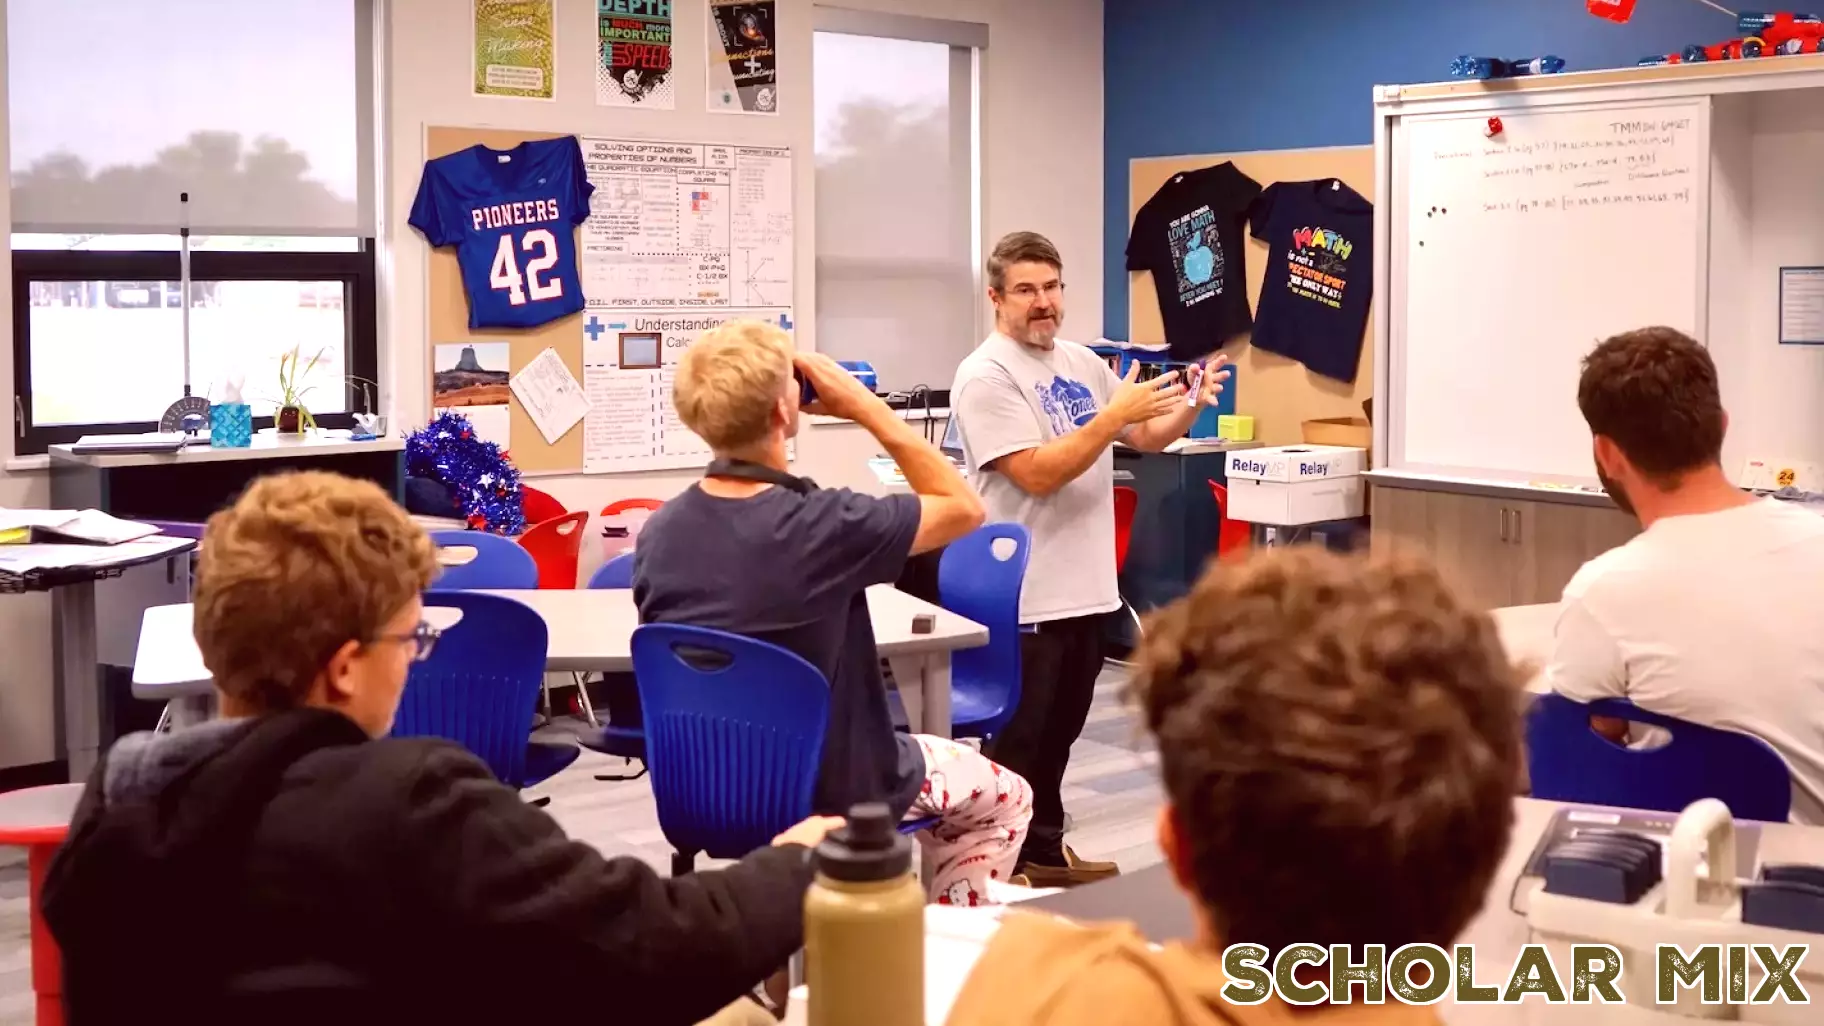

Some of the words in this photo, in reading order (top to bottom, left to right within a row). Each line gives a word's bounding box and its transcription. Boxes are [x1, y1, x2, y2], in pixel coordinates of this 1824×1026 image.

[599, 0, 671, 16] DEPTH
[600, 28, 671, 41] IMPORTANT
[645, 24, 671, 33] more
[622, 43, 670, 68] SPEED
[588, 153, 645, 162] PROPERTIES
[660, 156, 697, 164] NUMBERS
[594, 143, 634, 152] SOLVING
[636, 145, 674, 154] OPTIONS
[472, 198, 560, 231] PIONEERS
[1167, 221, 1190, 242] LOVE
[1190, 209, 1216, 232] MATH
[1293, 226, 1353, 260] MATH
[490, 228, 563, 306] 42
[1287, 261, 1324, 283] PECTATOR
[1302, 278, 1322, 293] ONLY
[1321, 285, 1339, 298] WAY
[1779, 471, 1795, 480] 24
